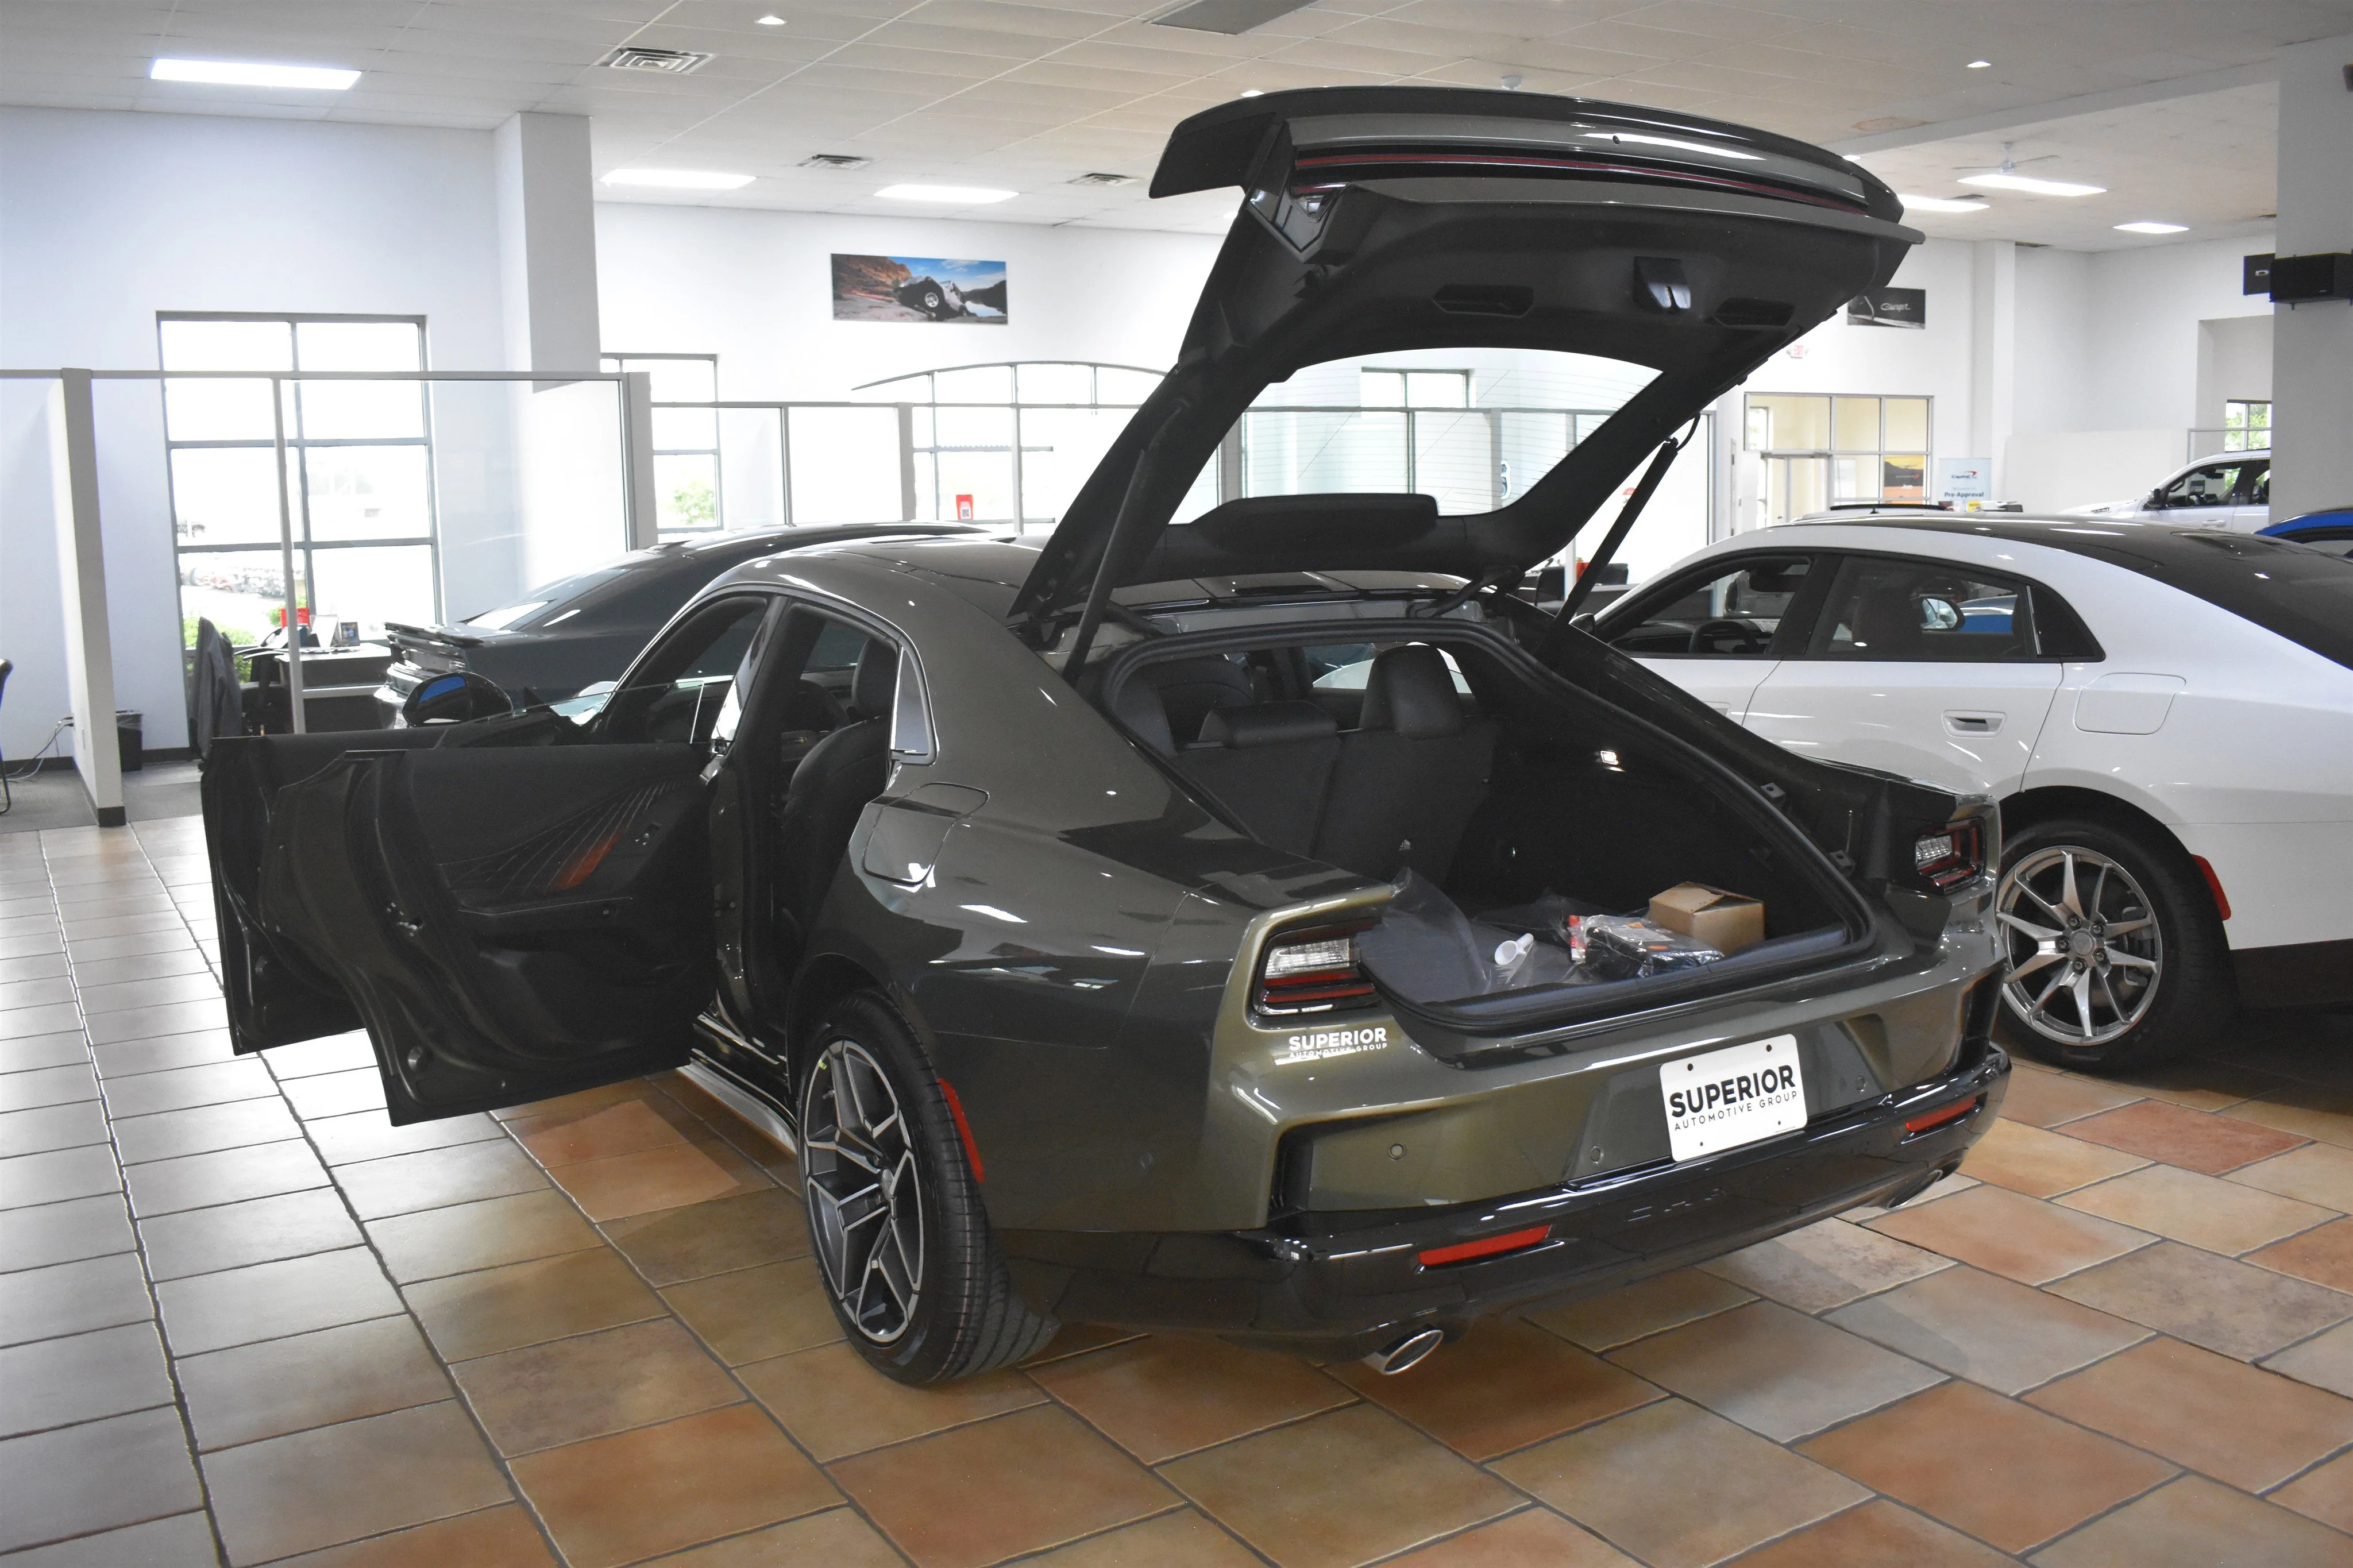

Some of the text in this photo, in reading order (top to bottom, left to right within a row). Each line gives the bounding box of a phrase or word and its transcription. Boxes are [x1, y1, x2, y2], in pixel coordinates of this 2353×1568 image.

[1289, 1027, 1387, 1051] SUPERIOR
[1356, 1042, 1387, 1052] GROUP
[1669, 1064, 1796, 1118] SUPERIOR
[1674, 1091, 1797, 1131] AUTOMOTIVE GROUP
